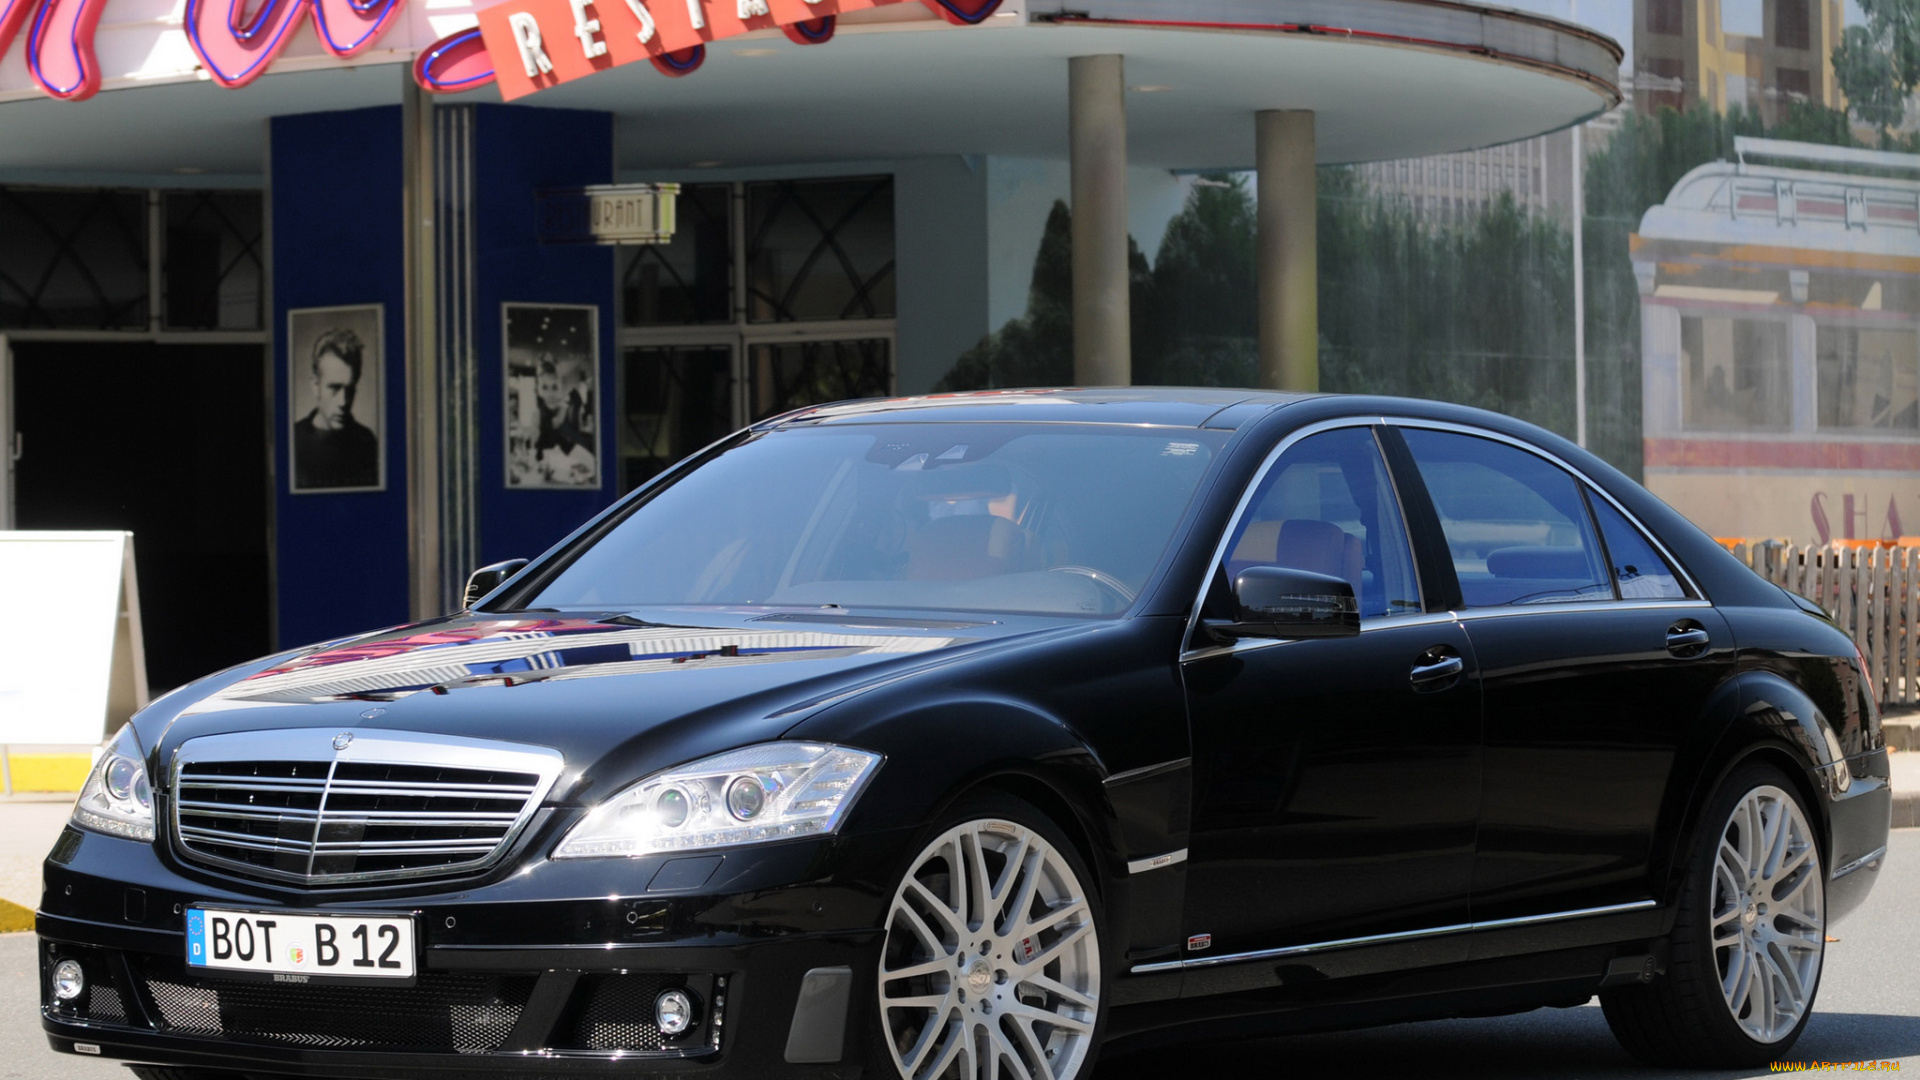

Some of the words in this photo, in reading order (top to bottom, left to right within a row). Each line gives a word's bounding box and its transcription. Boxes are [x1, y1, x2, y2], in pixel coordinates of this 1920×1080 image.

[1810, 491, 1920, 548] SHA
[193, 943, 201, 956] D
[212, 917, 277, 963] BOT
[315, 923, 340, 967] B
[352, 924, 401, 969] 12
[273, 973, 309, 984] BRABUS
